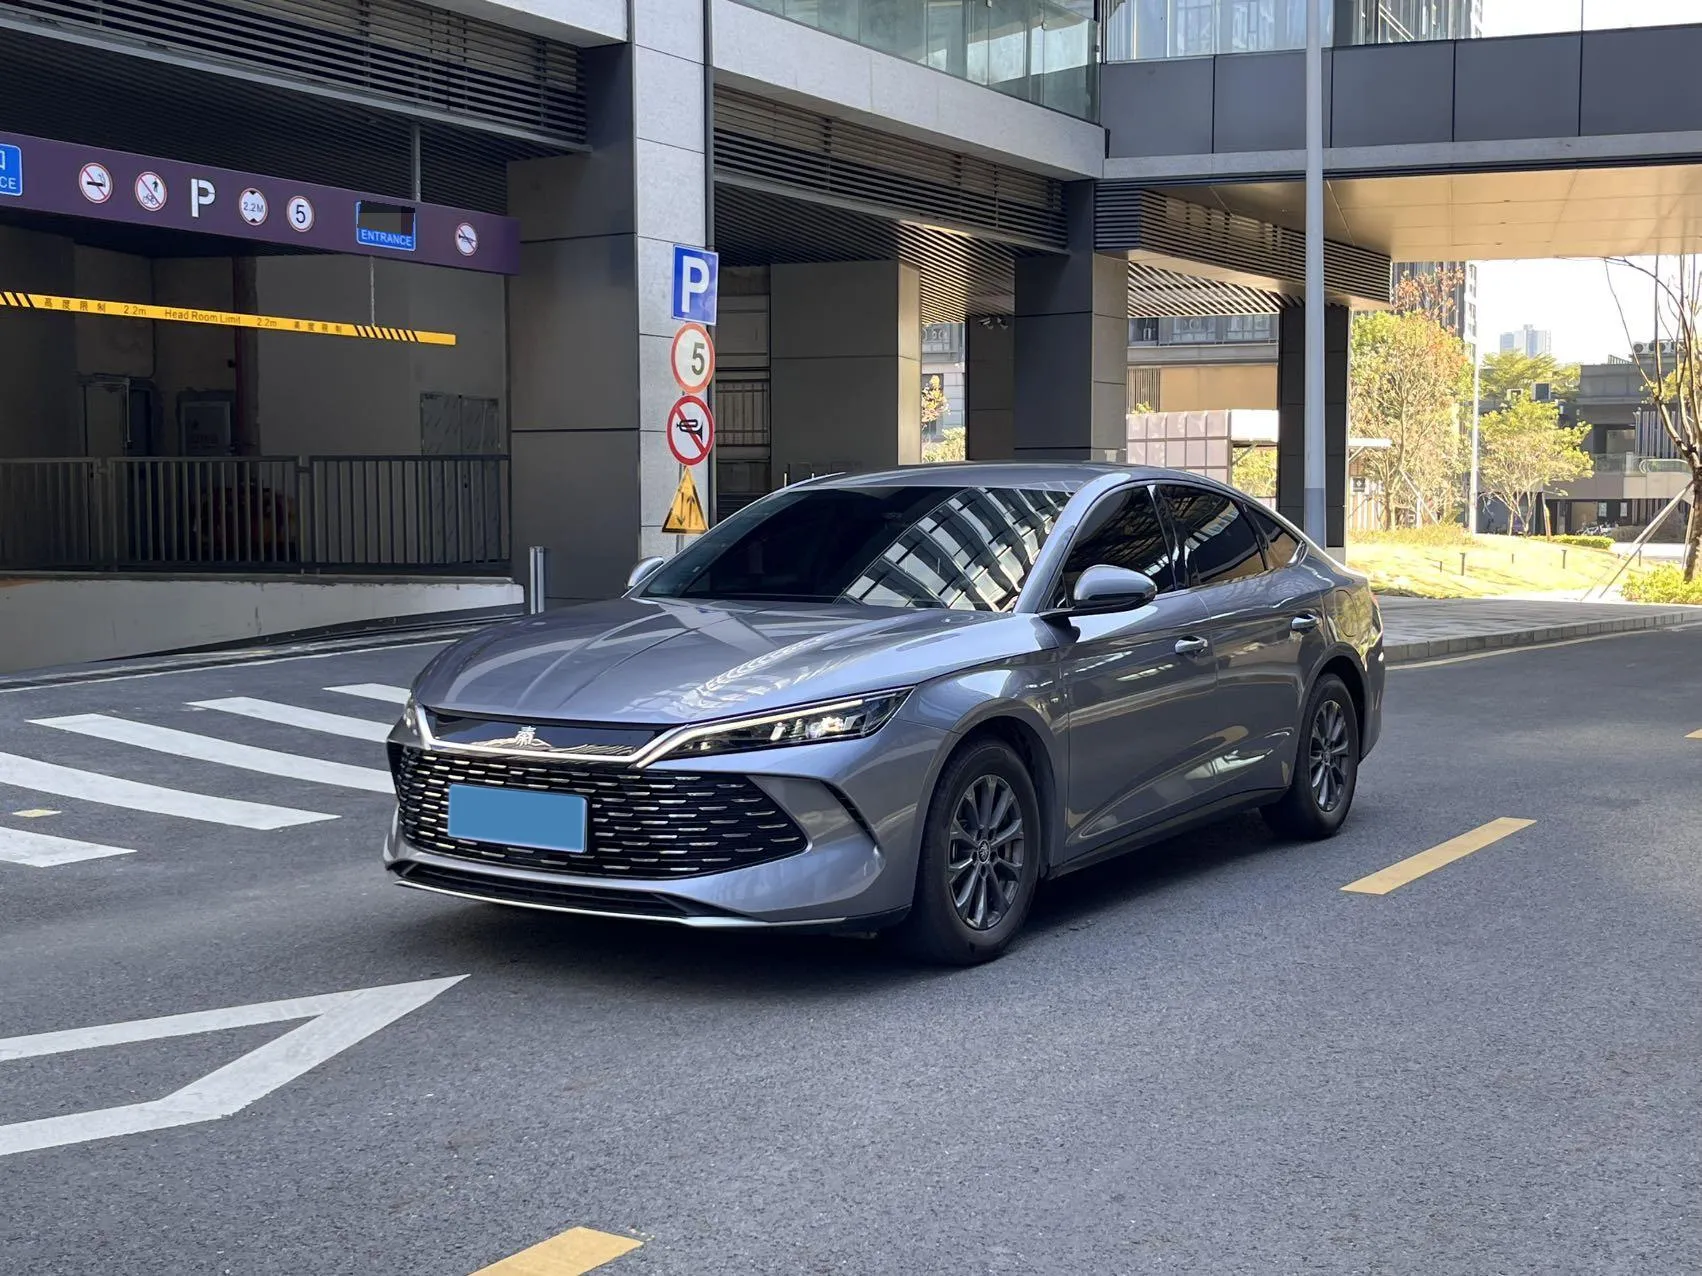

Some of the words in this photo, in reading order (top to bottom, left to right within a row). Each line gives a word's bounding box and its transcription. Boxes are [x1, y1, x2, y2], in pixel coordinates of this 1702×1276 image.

[190, 178, 216, 218] P
[243, 201, 265, 214] 2.2M
[295, 204, 307, 224] 5
[360, 228, 413, 247] ENTRANCE
[681, 255, 710, 313] P
[164, 308, 190, 320] Head
[191, 310, 218, 322] Room
[220, 314, 241, 325] Limit
[691, 341, 706, 376] 5
